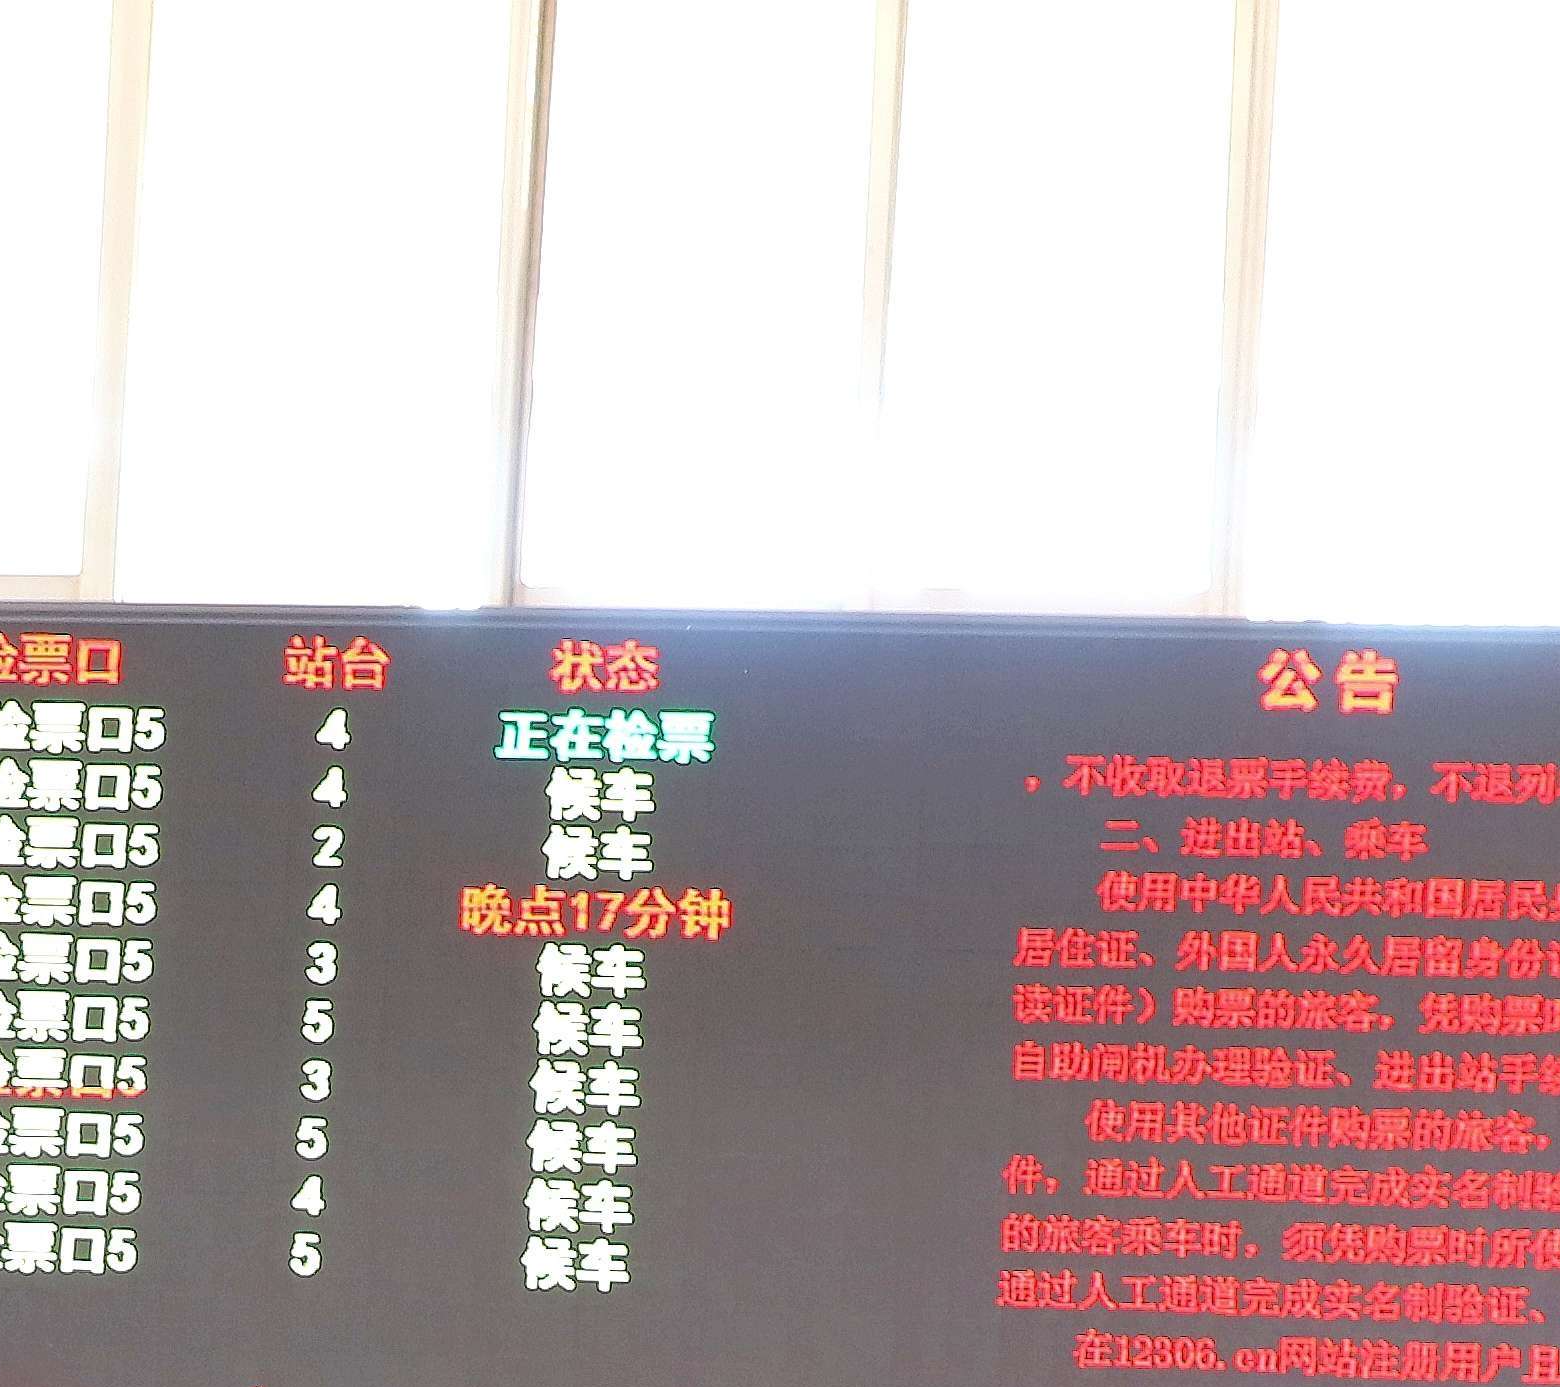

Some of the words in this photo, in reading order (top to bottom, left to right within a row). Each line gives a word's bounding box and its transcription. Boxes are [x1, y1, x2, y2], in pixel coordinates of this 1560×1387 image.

[284, 635, 390, 691] 站台
[549, 638, 658, 695] 状态
[1257, 649, 1398, 714] 公告
[316, 708, 350, 751] 4
[494, 707, 715, 765] 正在检票
[313, 765, 347, 809] 4
[545, 765, 655, 823] 候车
[313, 825, 343, 868] 2
[542, 823, 653, 882] 候车
[307, 883, 341, 926] 4
[458, 883, 731, 942] 晚点17分钟
[306, 941, 337, 985] 3
[536, 941, 646, 1000] 候车
[302, 999, 333, 1044] 5
[533, 999, 643, 1058] 候车
[300, 1059, 331, 1102] 3
[529, 1057, 640, 1117] 候车
[296, 1116, 327, 1160] 5
[526, 1118, 637, 1175] 候车
[292, 1174, 325, 1217] 4
[524, 1176, 633, 1235] 候车
[290, 1232, 321, 1277] 5
[520, 1235, 630, 1293] 候车
